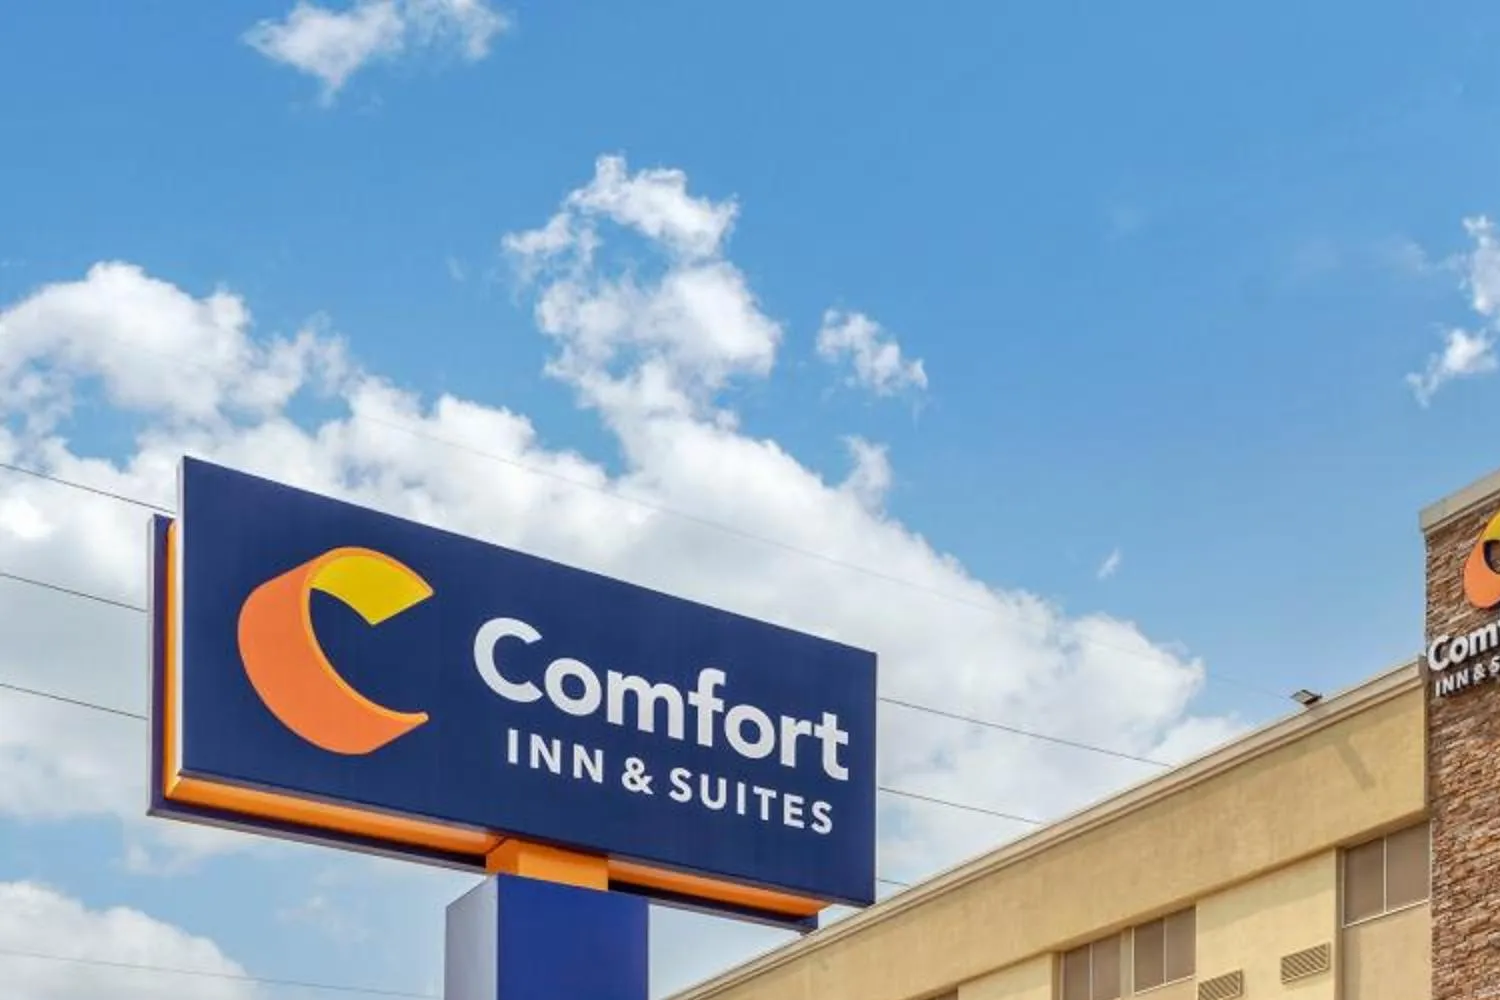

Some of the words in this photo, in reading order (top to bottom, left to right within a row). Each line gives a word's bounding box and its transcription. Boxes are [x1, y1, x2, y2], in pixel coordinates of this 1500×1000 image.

[473, 617, 849, 781] Comfort
[1435, 668, 1470, 697] INN
[1473, 663, 1486, 684] &
[507, 727, 603, 783] INN
[621, 757, 653, 795] &
[668, 767, 833, 834] SUITES
